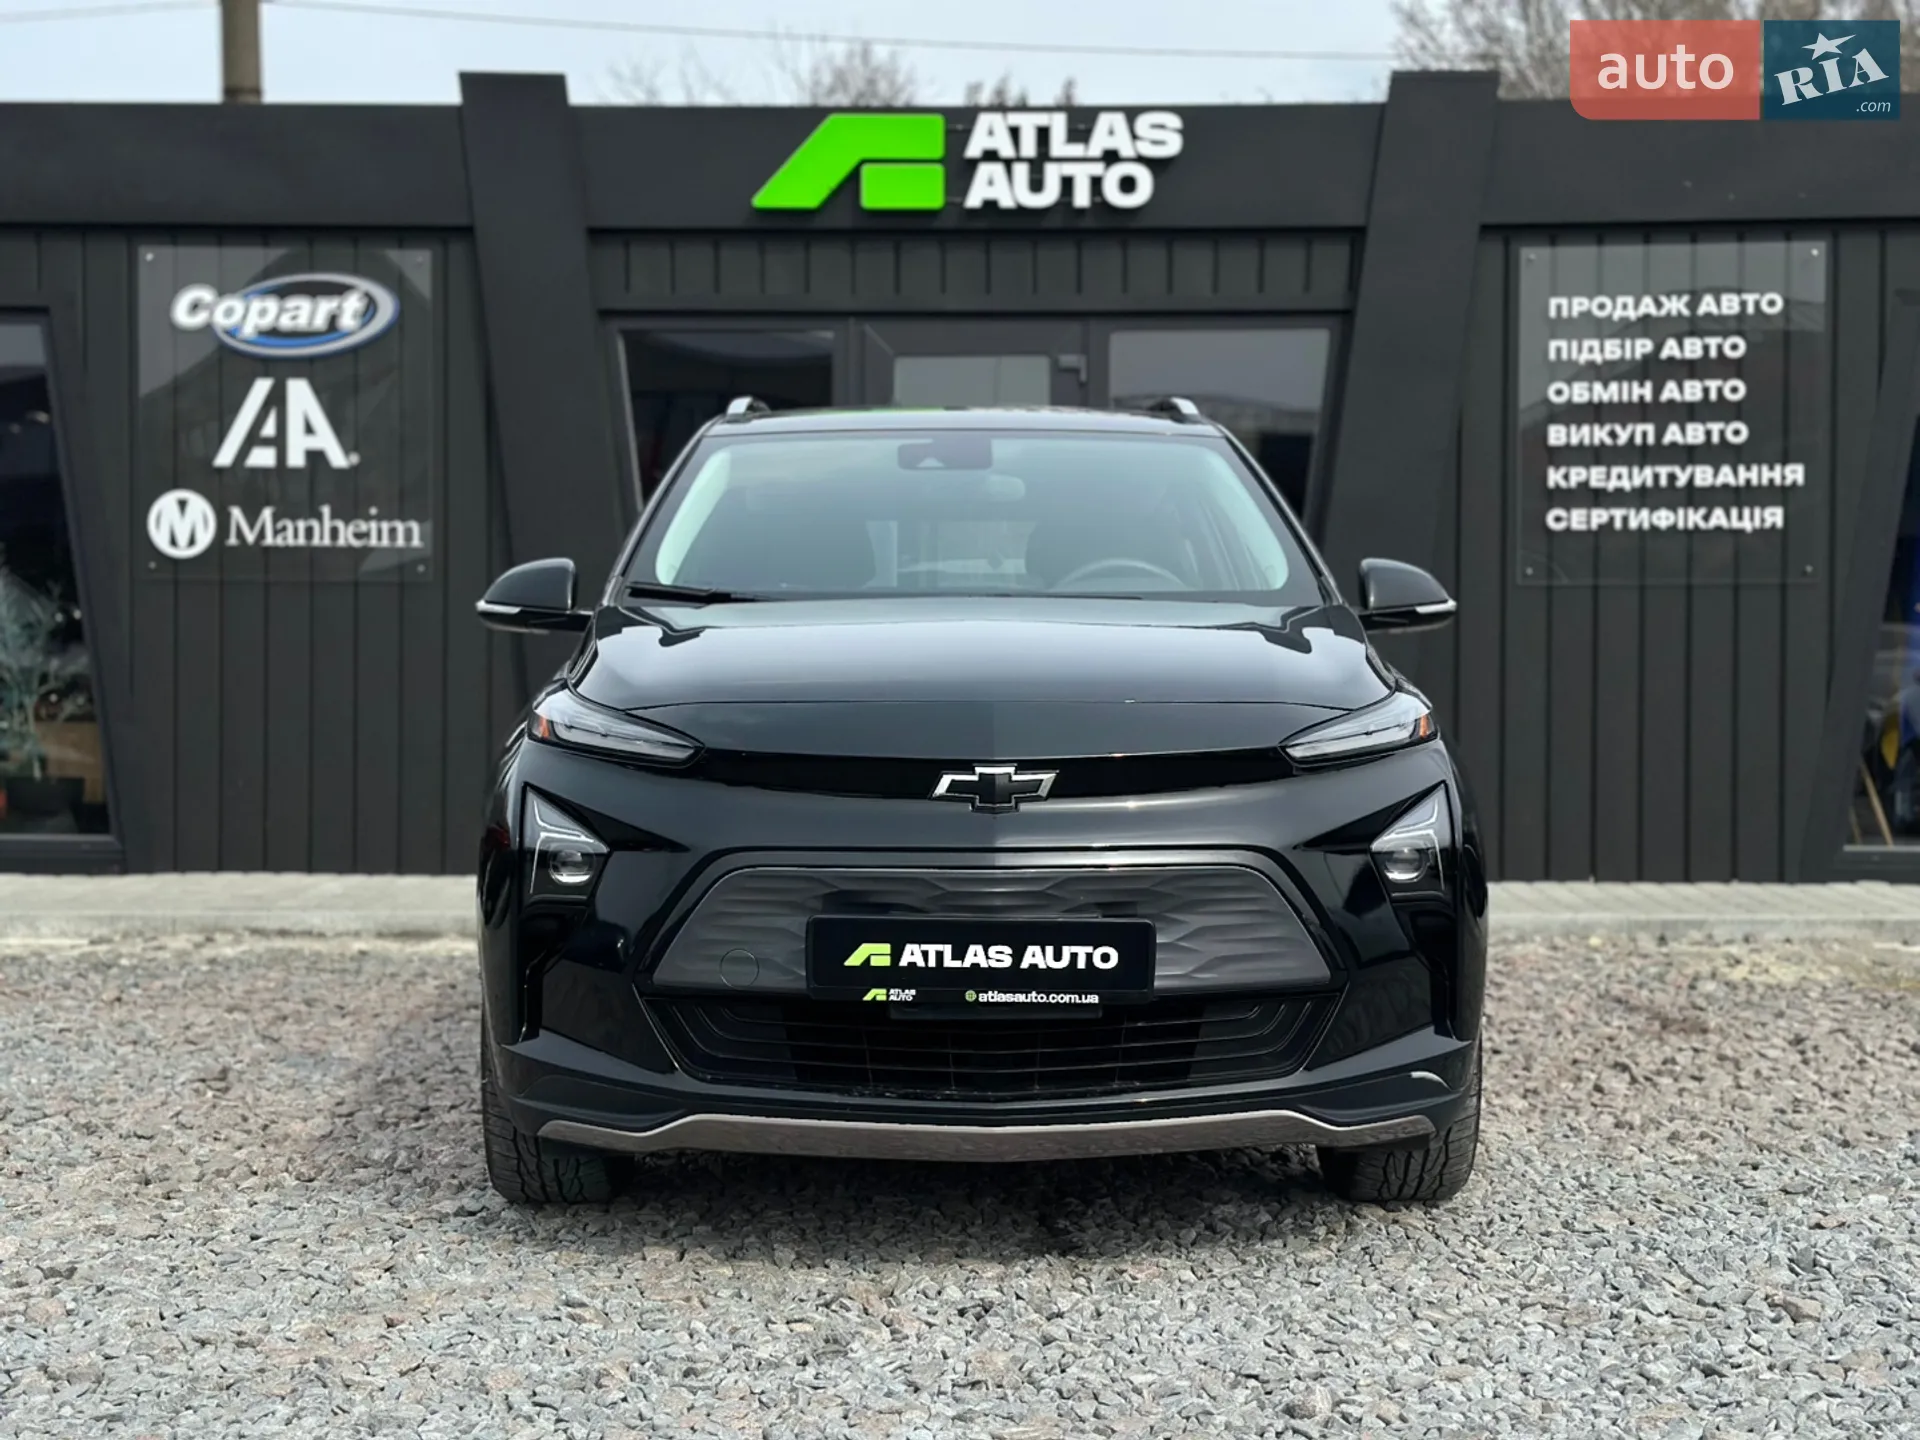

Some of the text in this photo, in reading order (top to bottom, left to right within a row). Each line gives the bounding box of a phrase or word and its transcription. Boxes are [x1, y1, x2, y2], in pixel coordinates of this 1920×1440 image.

[963, 111, 1184, 159] ATLAS
[963, 161, 1154, 209] AUTO
[171, 284, 369, 339] Copart
[1548, 292, 1785, 321] ПРОДАЖ АВТО
[1548, 335, 1747, 365] ПІДБІР АВТО
[1547, 379, 1747, 404] ОБМІН АВТО
[1547, 421, 1749, 447] ВИКУП АВТО
[1546, 463, 1805, 492] КРЕДИТУВАННЯ
[224, 504, 424, 548] Manheim
[1545, 506, 1784, 533] СЕРТИФІКАЦІЯ
[899, 943, 1119, 969] ATLAS AUTO
[978, 990, 1099, 1004] atlasauto.com.ua
